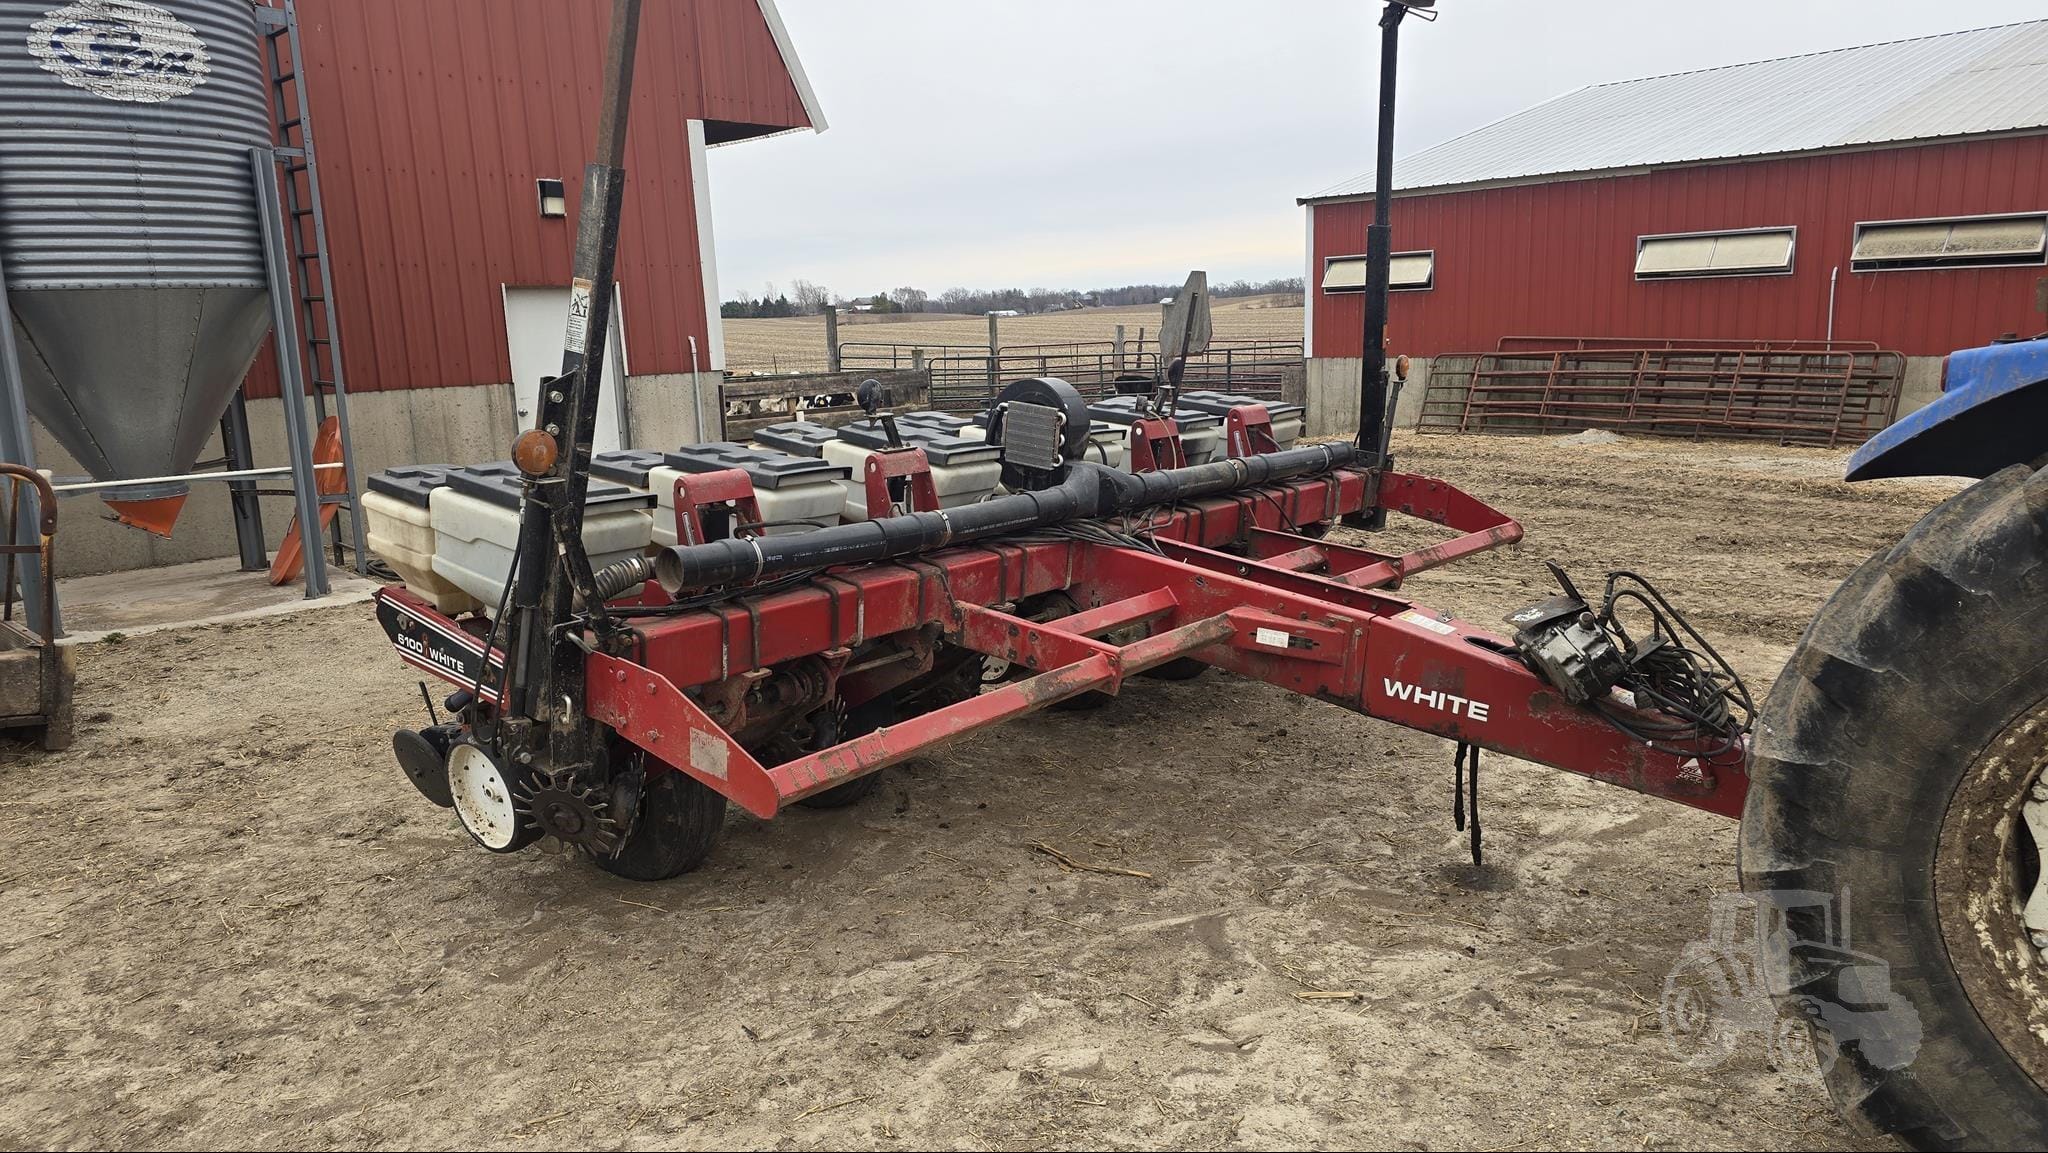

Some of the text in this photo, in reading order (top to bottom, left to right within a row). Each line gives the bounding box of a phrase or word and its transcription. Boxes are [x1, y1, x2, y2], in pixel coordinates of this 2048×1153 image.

[397, 633, 465, 673] 6100 WHITE
[1383, 677, 1490, 722] WHITE
